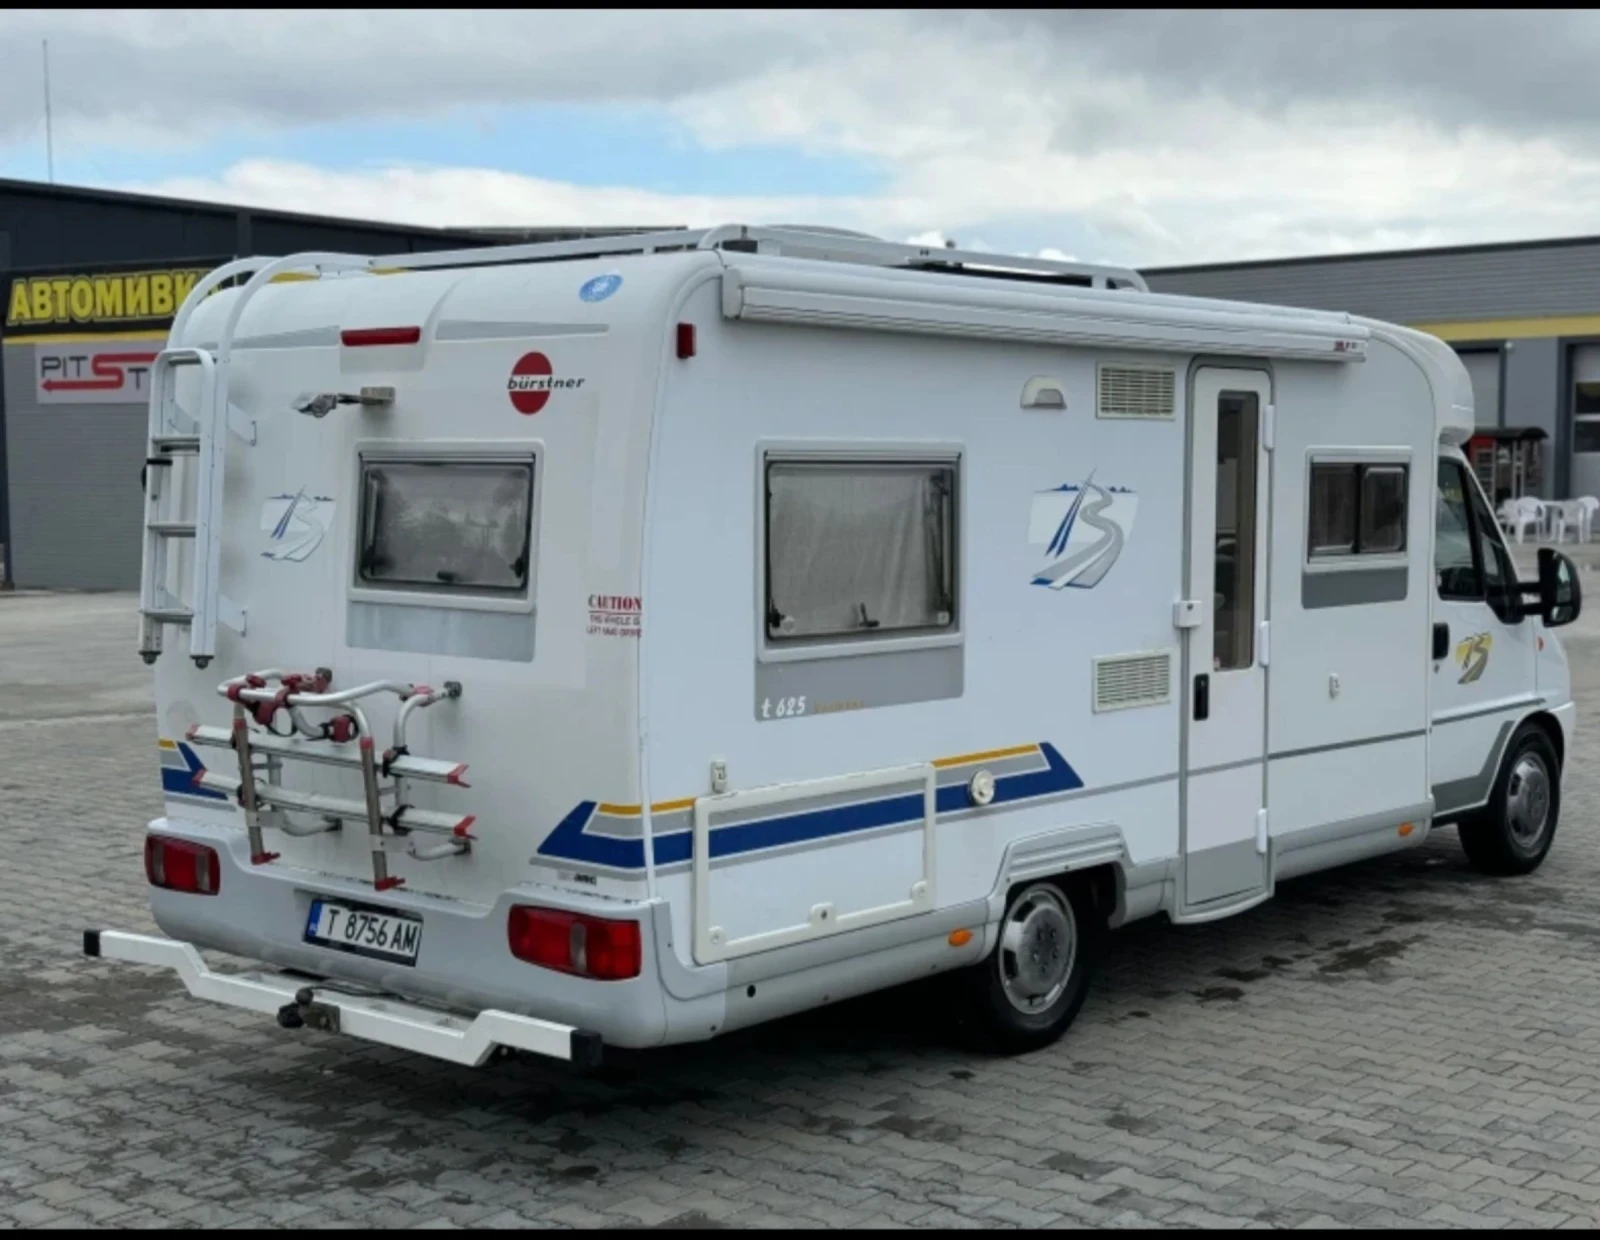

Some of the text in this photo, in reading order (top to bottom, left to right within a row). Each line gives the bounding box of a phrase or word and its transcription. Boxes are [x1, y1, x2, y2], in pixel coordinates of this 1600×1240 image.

[8, 270, 222, 323] АВТОМИВК
[507, 376, 585, 390] bürstner
[761, 697, 772, 718] t
[776, 696, 806, 717] 625
[328, 908, 340, 936] T
[344, 913, 388, 947] 8756
[389, 923, 418, 953] AM
